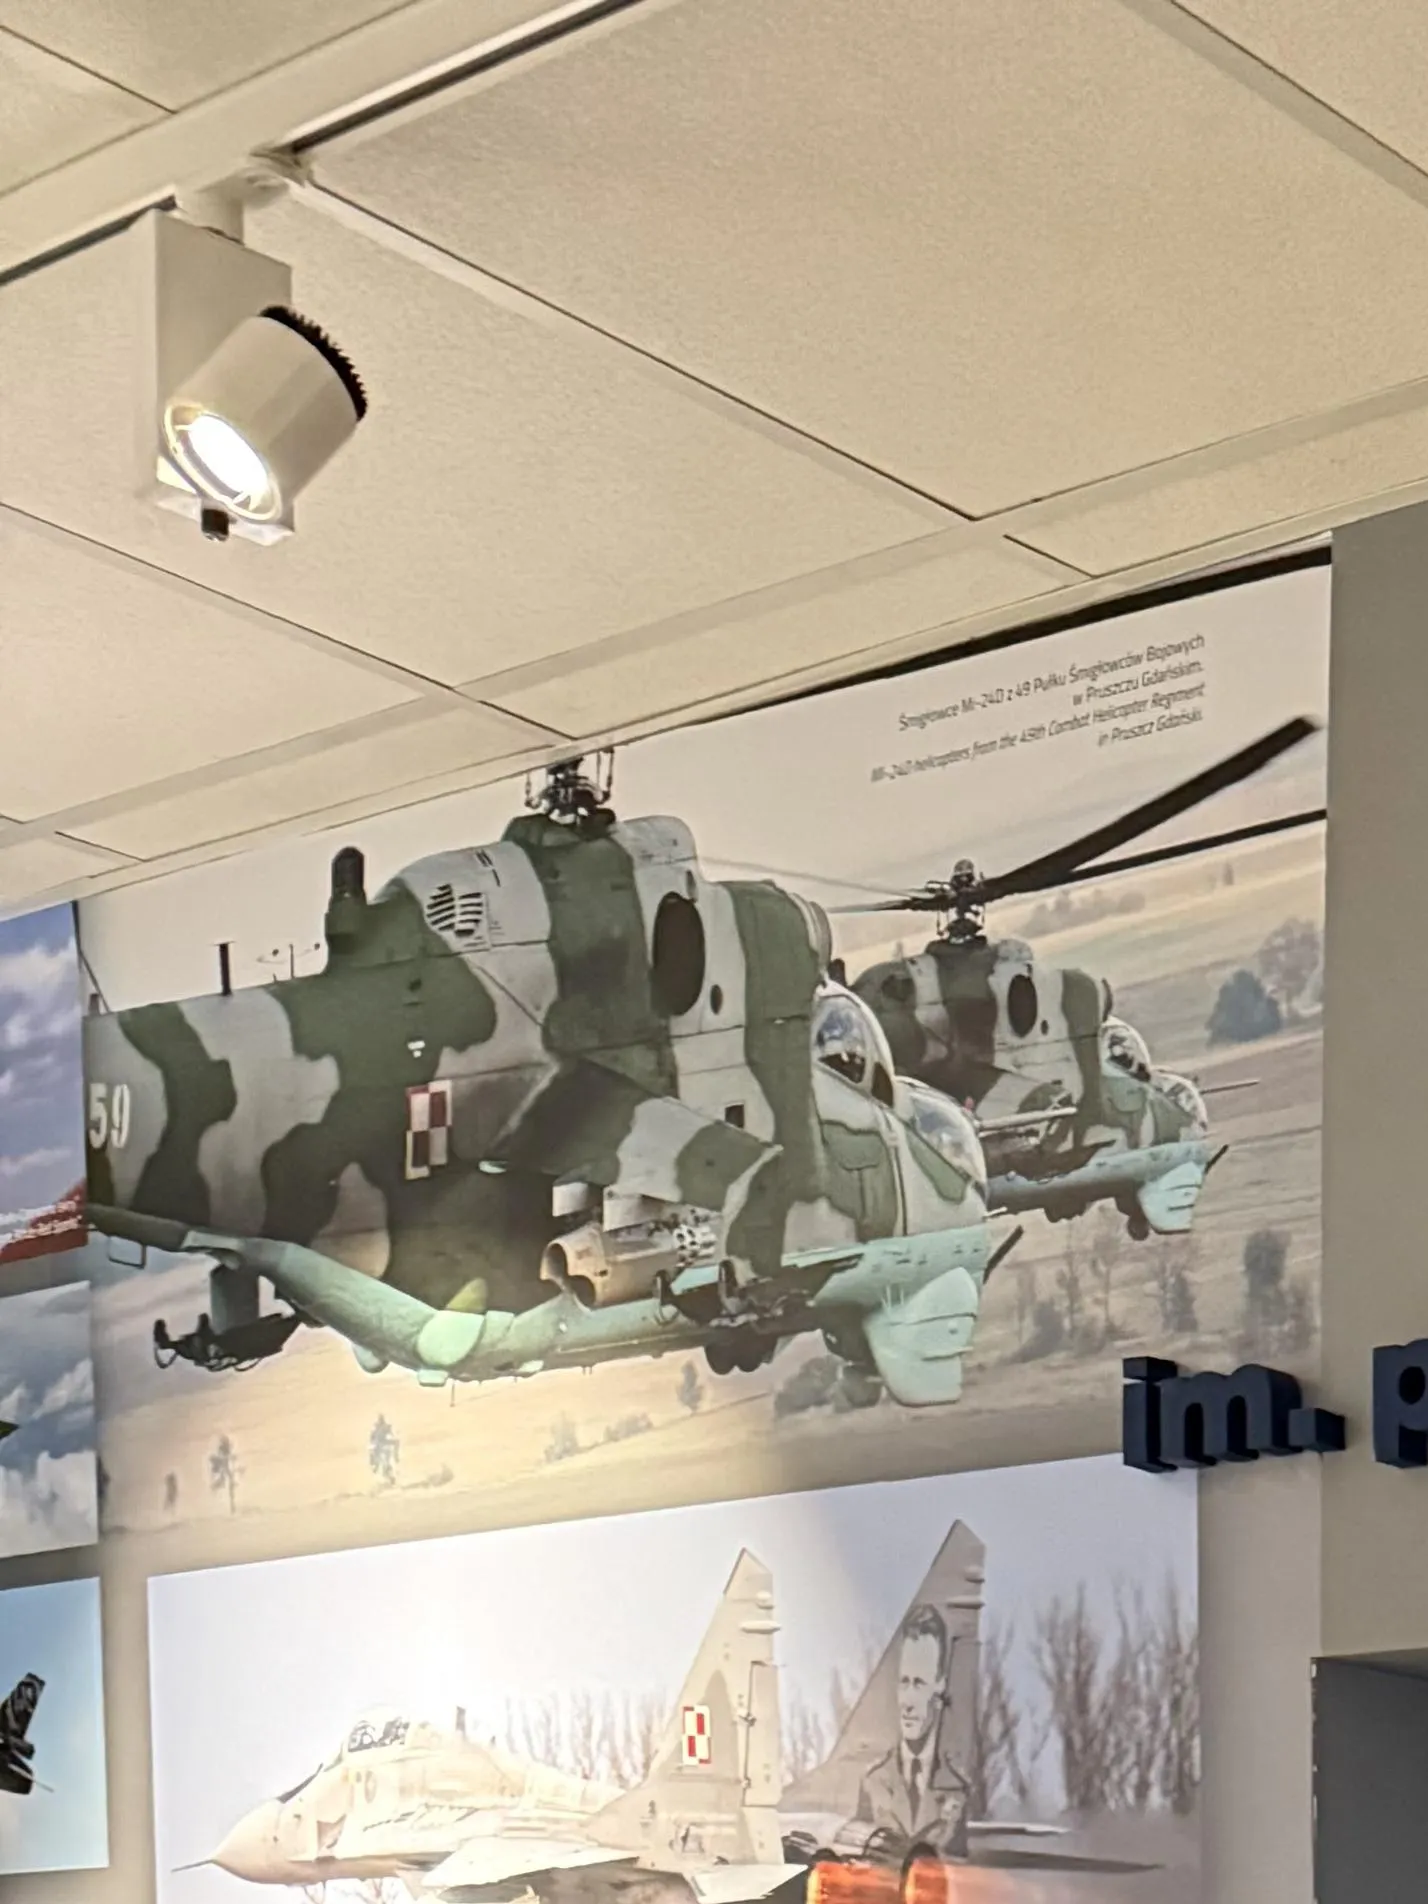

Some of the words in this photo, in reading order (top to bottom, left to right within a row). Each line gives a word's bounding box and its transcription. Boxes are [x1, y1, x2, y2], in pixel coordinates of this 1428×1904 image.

[1015, 681, 1031, 698] 49
[1033, 673, 1066, 693] Pułku
[1146, 633, 1205, 661] Bojowych
[1086, 678, 1139, 702] Pruszczu
[970, 738, 997, 760] from
[999, 733, 1017, 749] the
[1048, 713, 1091, 738] Combat
[1110, 721, 1154, 744] Pruszcz
[89, 1083, 130, 1149] 59
[1123, 1360, 1343, 1473] im.
